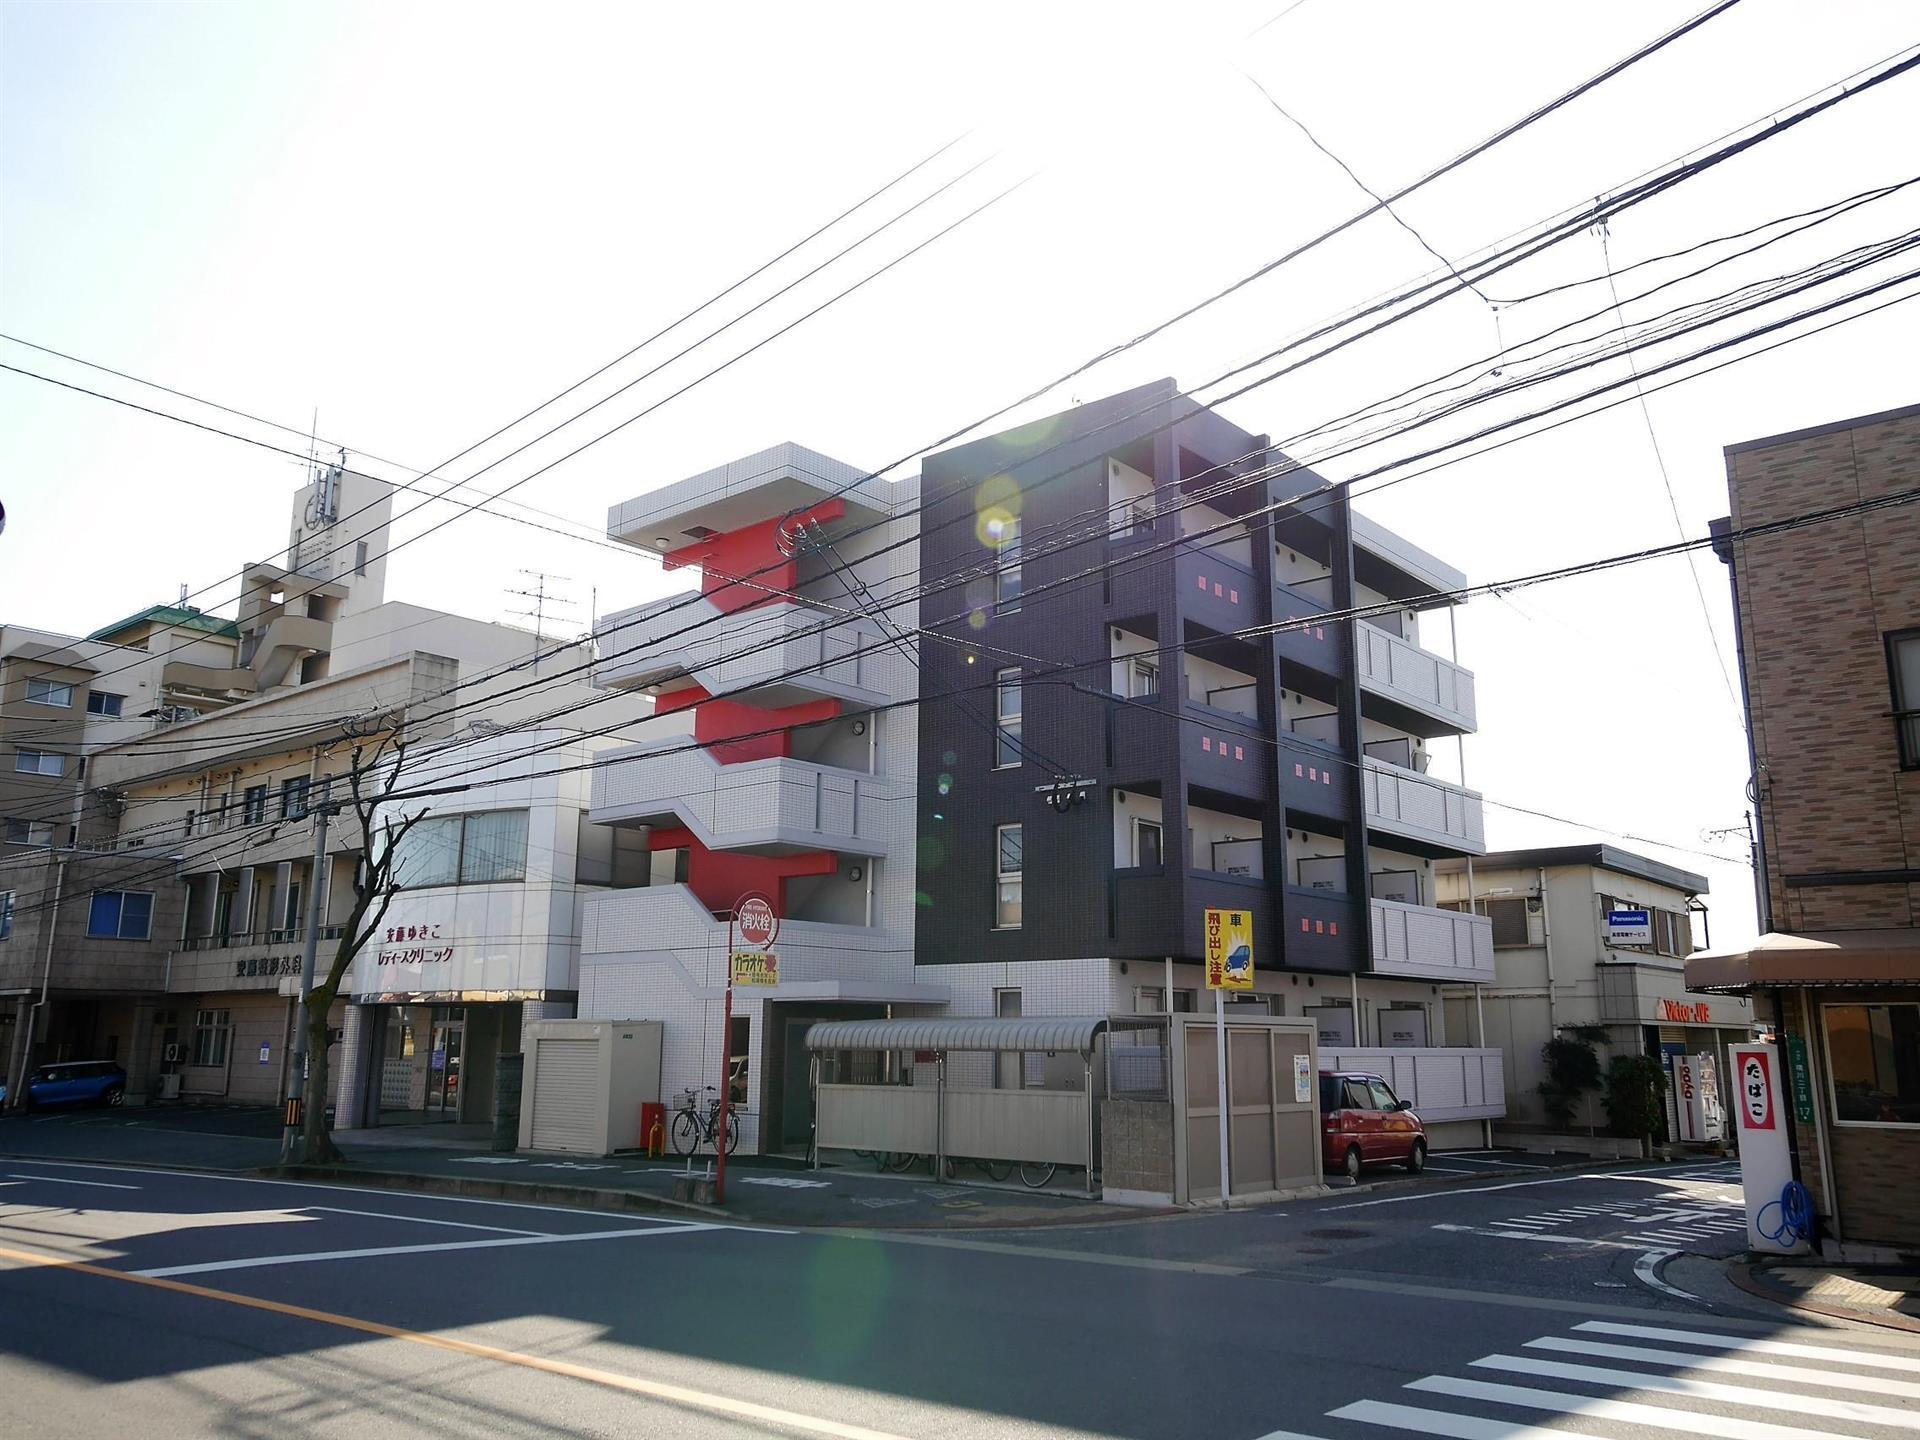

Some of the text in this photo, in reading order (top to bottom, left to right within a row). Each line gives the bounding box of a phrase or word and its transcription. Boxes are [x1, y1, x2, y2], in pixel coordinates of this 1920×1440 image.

[742, 912, 770, 931] 消火栓
[1230, 913, 1242, 927] 車
[378, 947, 453, 966] レディースクリニック
[1208, 912, 1222, 986] 飛び出し注意
[1682, 1066, 1695, 1099] DyDo
[1746, 1063, 1765, 1117] たばこ
